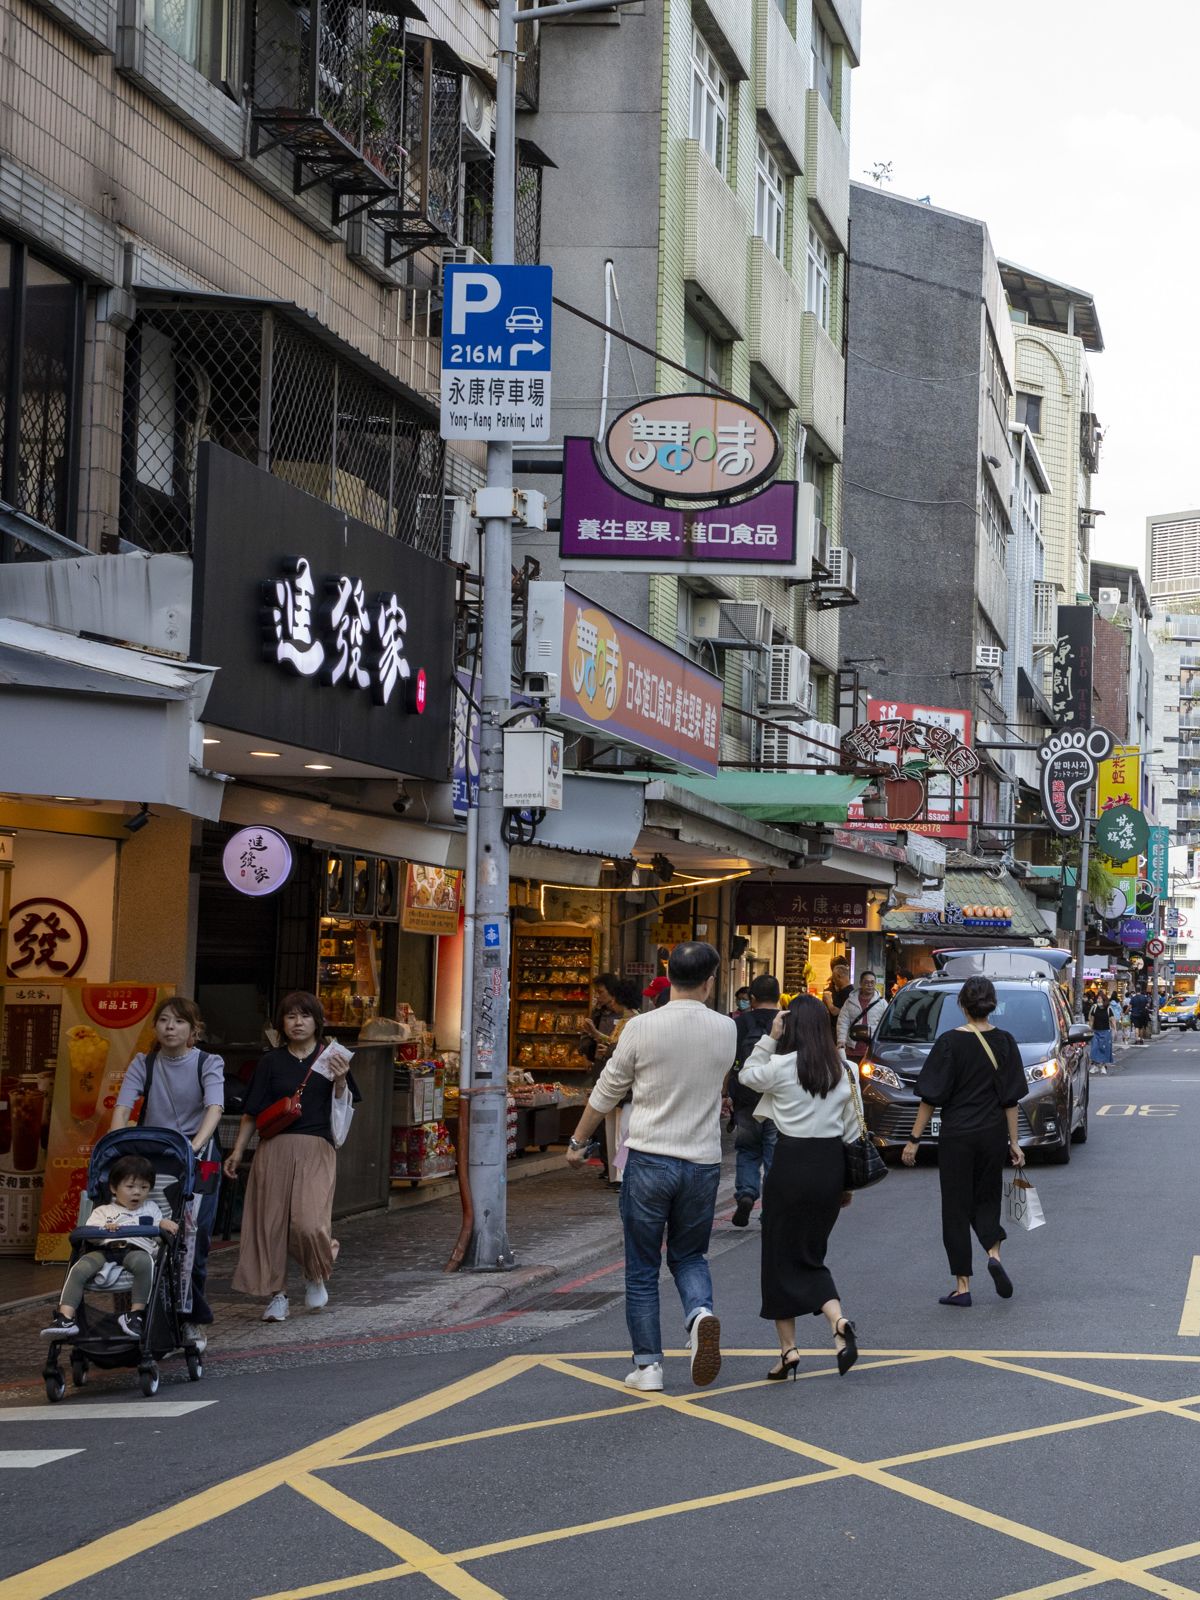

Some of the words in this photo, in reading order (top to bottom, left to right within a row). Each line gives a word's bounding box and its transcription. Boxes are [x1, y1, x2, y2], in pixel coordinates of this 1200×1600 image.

[451, 273, 501, 334] P
[450, 344, 502, 364] 216M
[448, 377, 545, 407] 永康停車場
[449, 411, 492, 429] Yong-Kang
[496, 411, 527, 429] Parking
[530, 411, 544, 427] Lot
[273, 556, 411, 704] 進發家
[12, 911, 71, 971] 發
[98, 1000, 139, 1010] 新品上市
